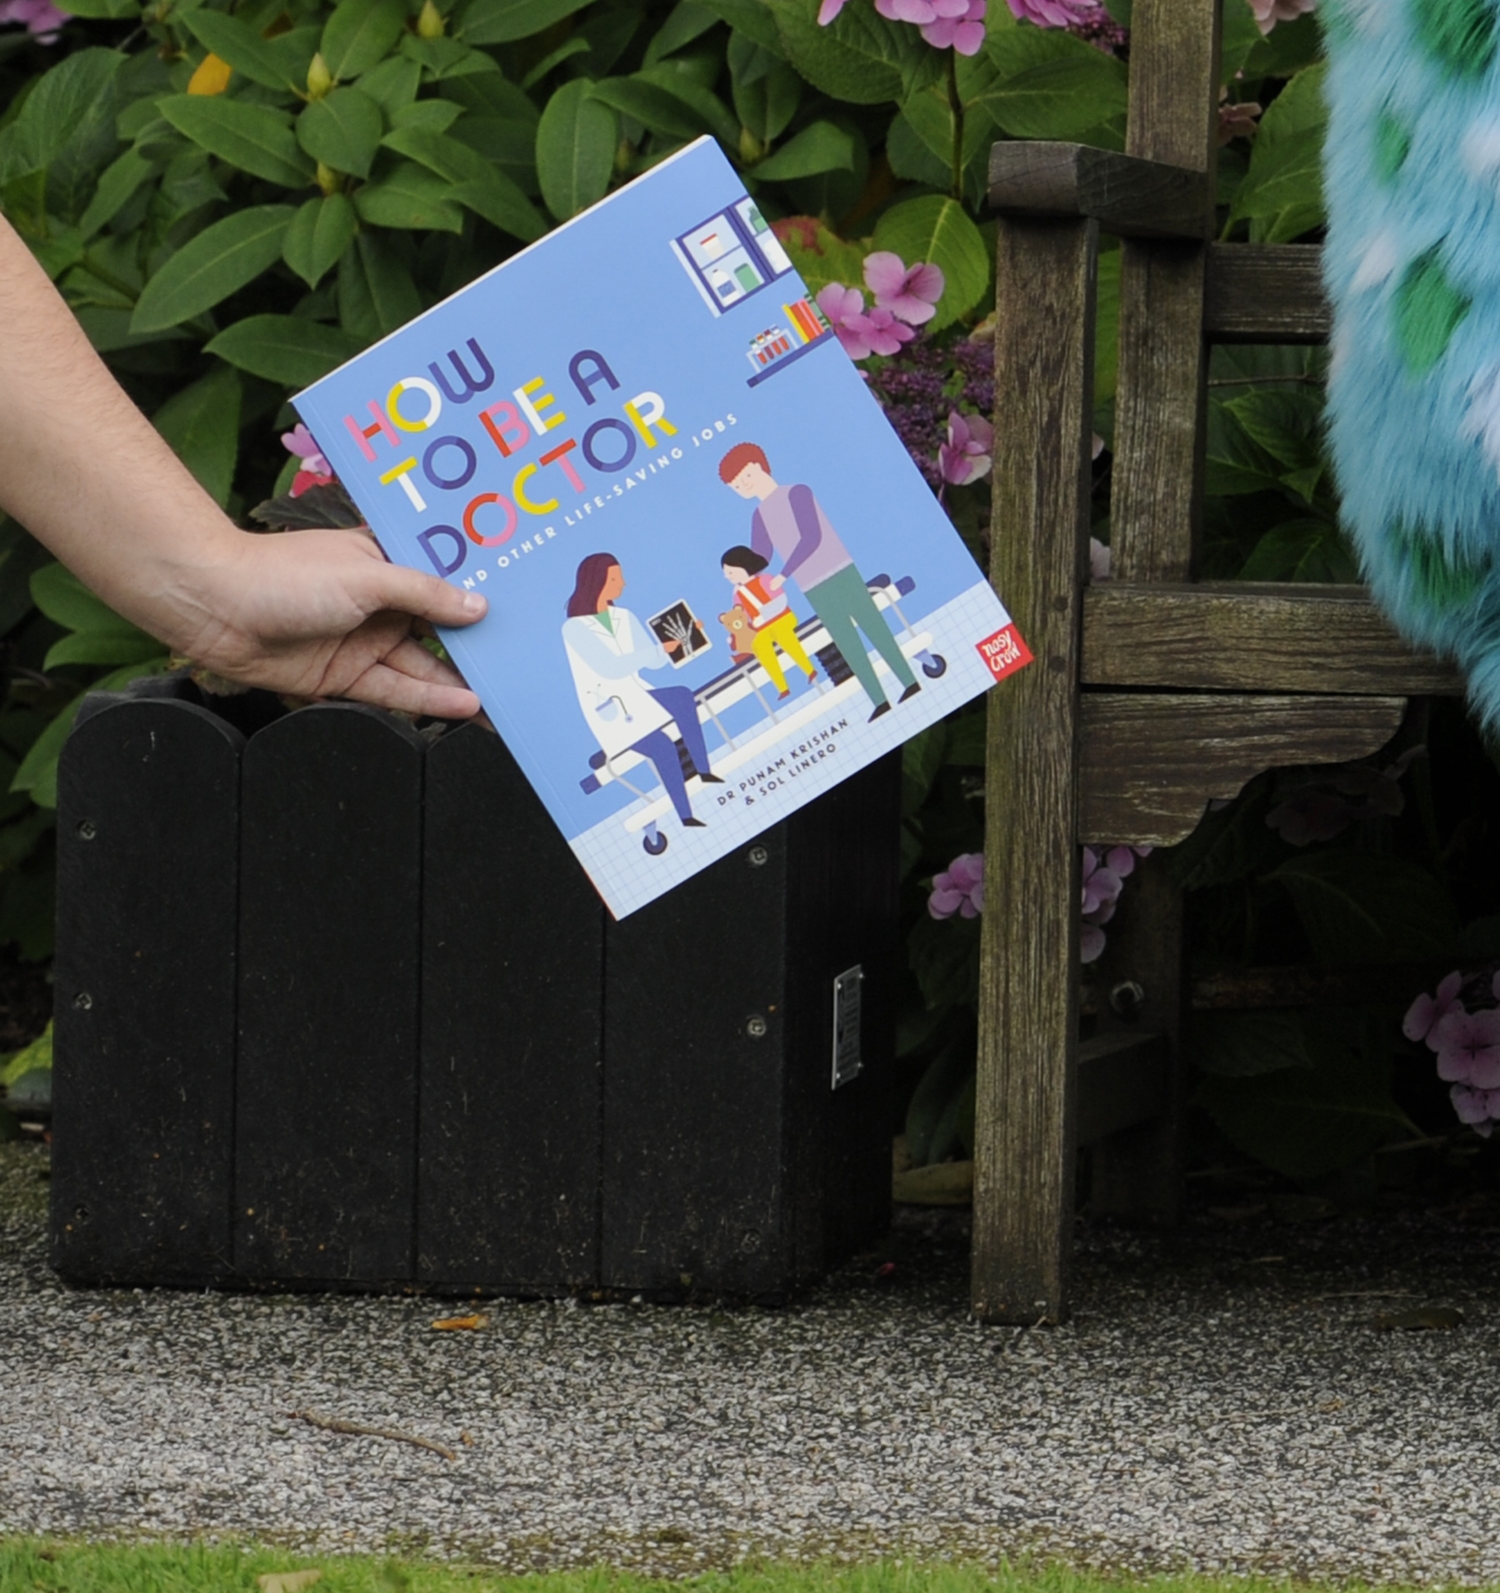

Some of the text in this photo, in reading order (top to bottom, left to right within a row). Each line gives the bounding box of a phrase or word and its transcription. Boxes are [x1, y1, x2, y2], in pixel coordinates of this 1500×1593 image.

[342, 337, 495, 464] HOW
[379, 349, 621, 513] TO BE A
[416, 391, 678, 579] DOCTOR
[462, 413, 737, 590] ND OTHER LIFE-SAVING JOBS
[981, 629, 1012, 658] nosy
[990, 641, 1021, 672] crow
[717, 718, 848, 806] DR PUNAM KRISHAN
[745, 743, 836, 806] & SOL LINERO
